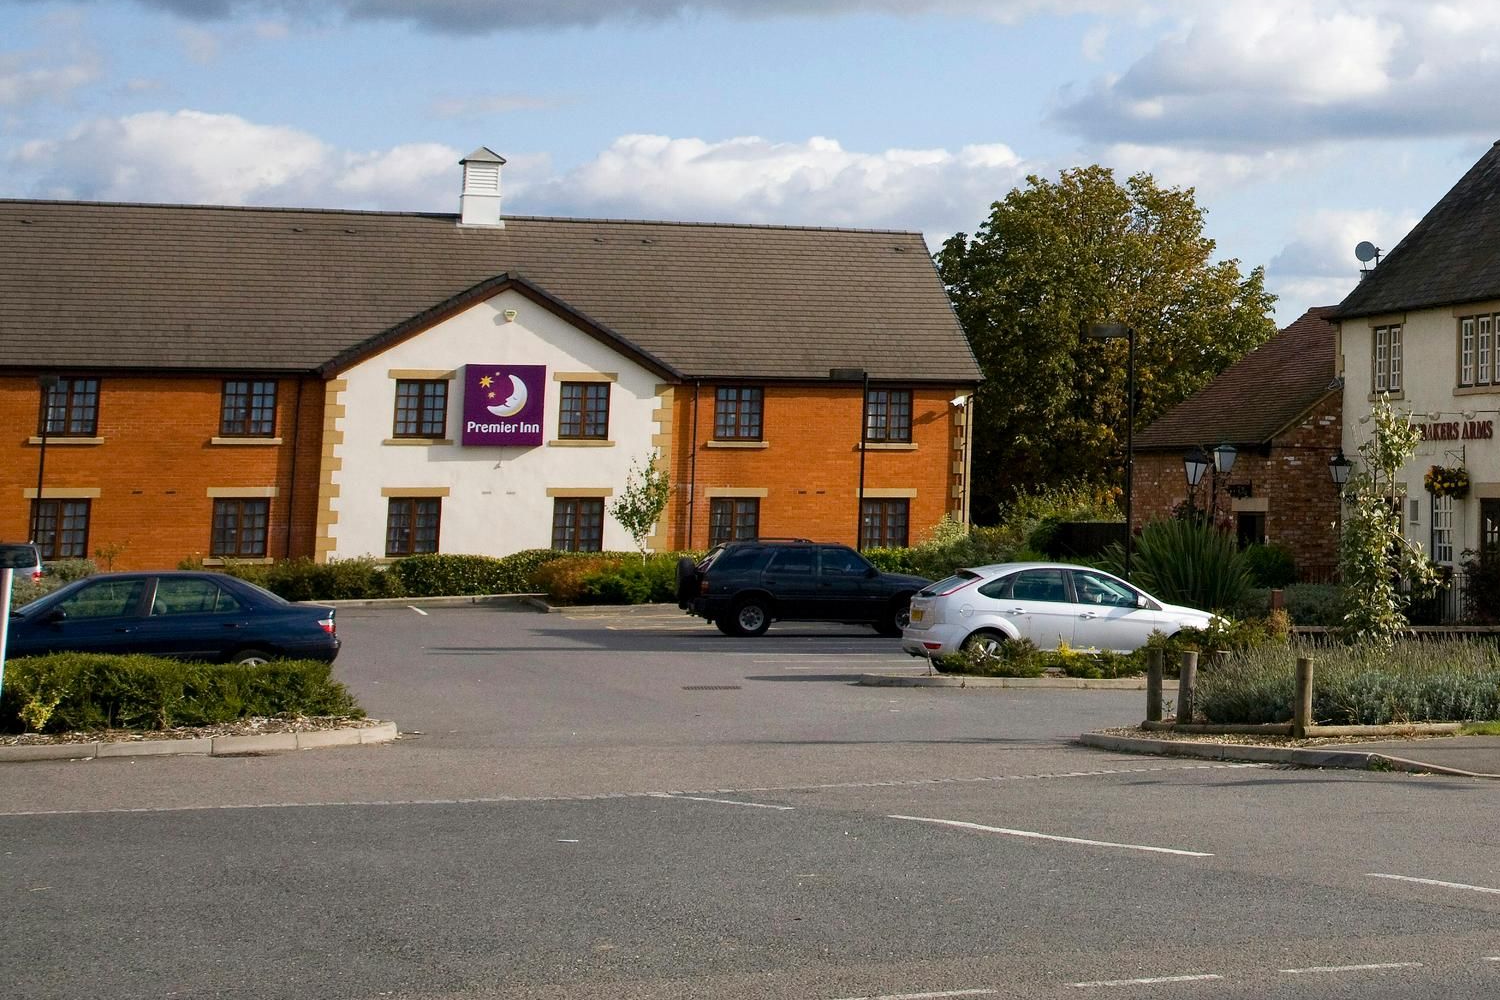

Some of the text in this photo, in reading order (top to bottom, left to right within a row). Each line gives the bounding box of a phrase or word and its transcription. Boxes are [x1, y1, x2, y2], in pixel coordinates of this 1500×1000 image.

[467, 421, 540, 433] Premier Inn
[1461, 420, 1493, 440] ARMS
